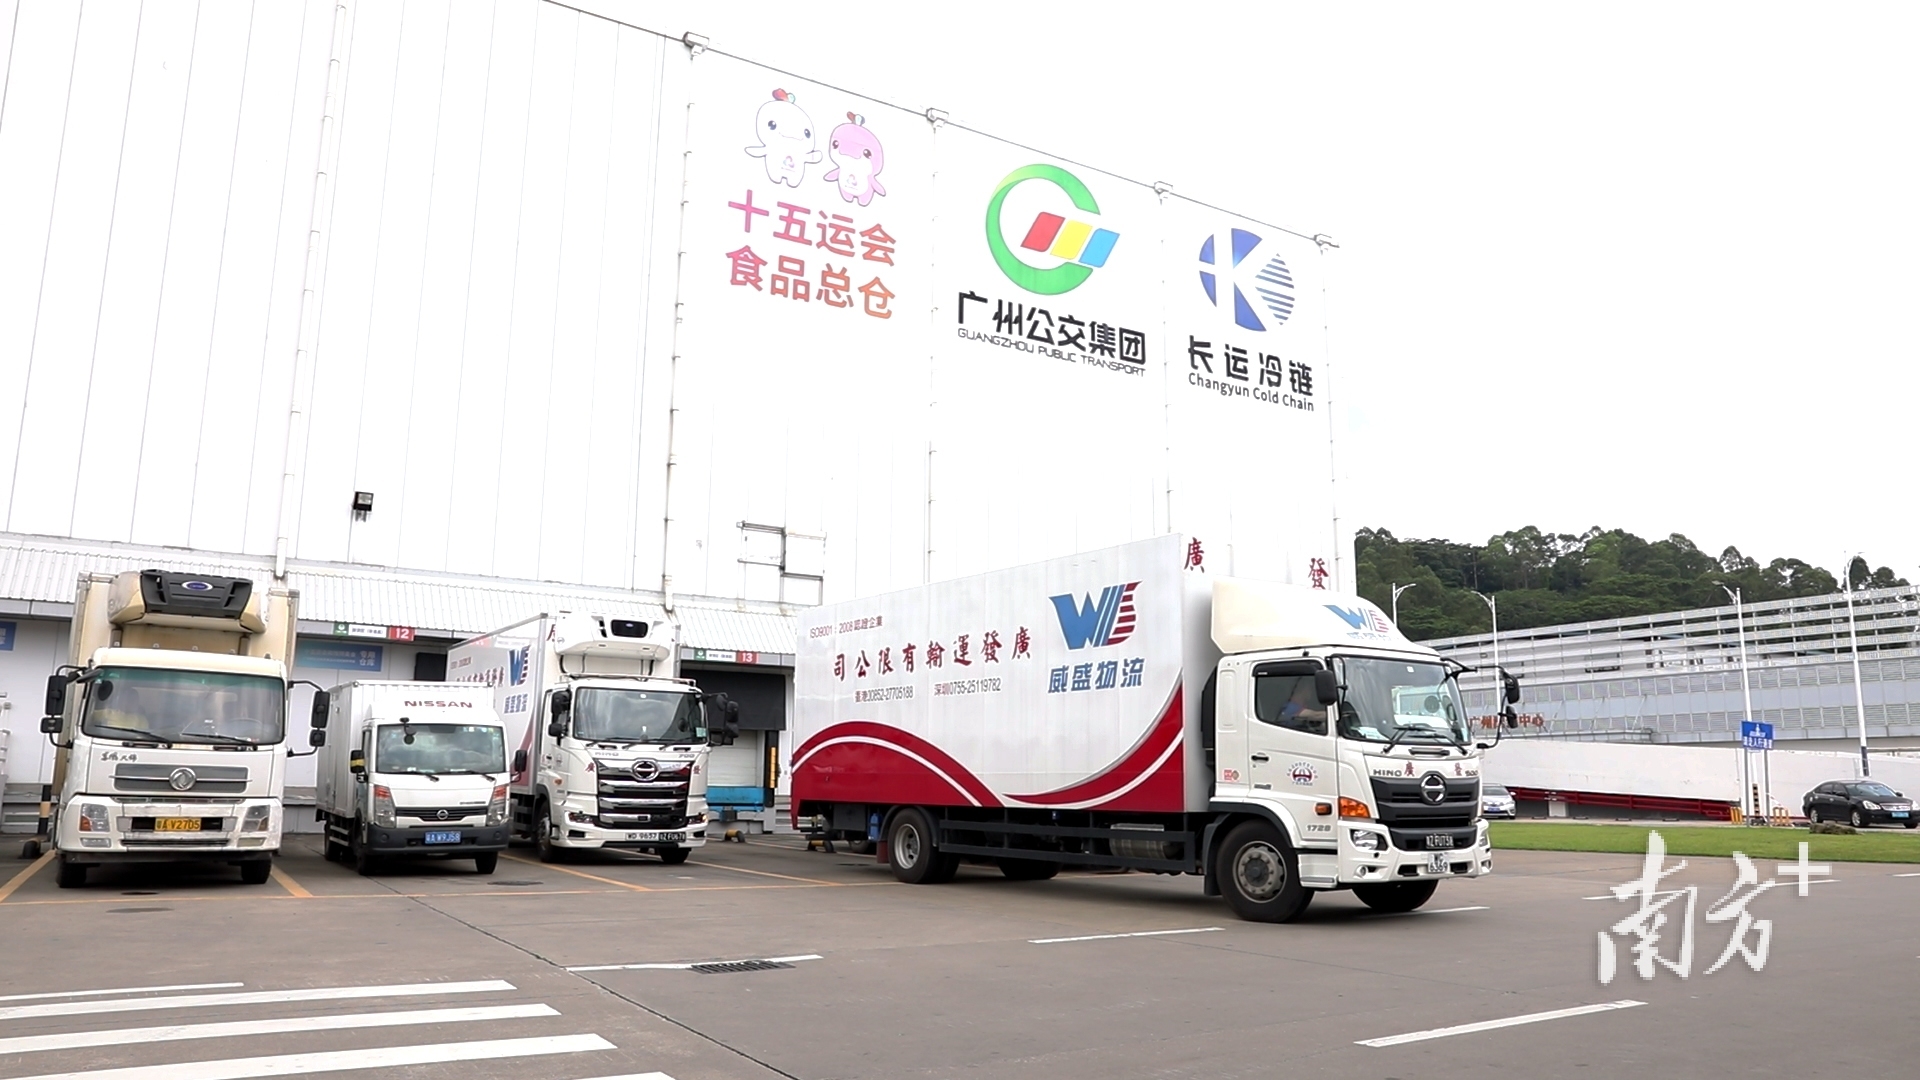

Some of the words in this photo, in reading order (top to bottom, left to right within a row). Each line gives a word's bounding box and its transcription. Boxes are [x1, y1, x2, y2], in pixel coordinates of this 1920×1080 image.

[728, 189, 896, 267] 十五运会
[725, 245, 896, 319] 食品总仓
[958, 291, 1146, 365] 广州公交集团
[958, 328, 1034, 353] GUANGZHOU
[1038, 345, 1077, 363] PUBLIC
[1081, 355, 1146, 377] TRANSPORT
[1188, 335, 1313, 396] 长运冷链
[1188, 372, 1249, 397] Changyun
[1253, 387, 1279, 404] Cold
[1282, 394, 1314, 411] Chain
[396, 628, 409, 639] 12
[742, 652, 753, 662] 13
[1048, 658, 1145, 693] 威盛物流
[404, 700, 472, 708] NISSAN
[1470, 714, 1544, 729] 广州中心
[1373, 769, 1403, 777] HINO
